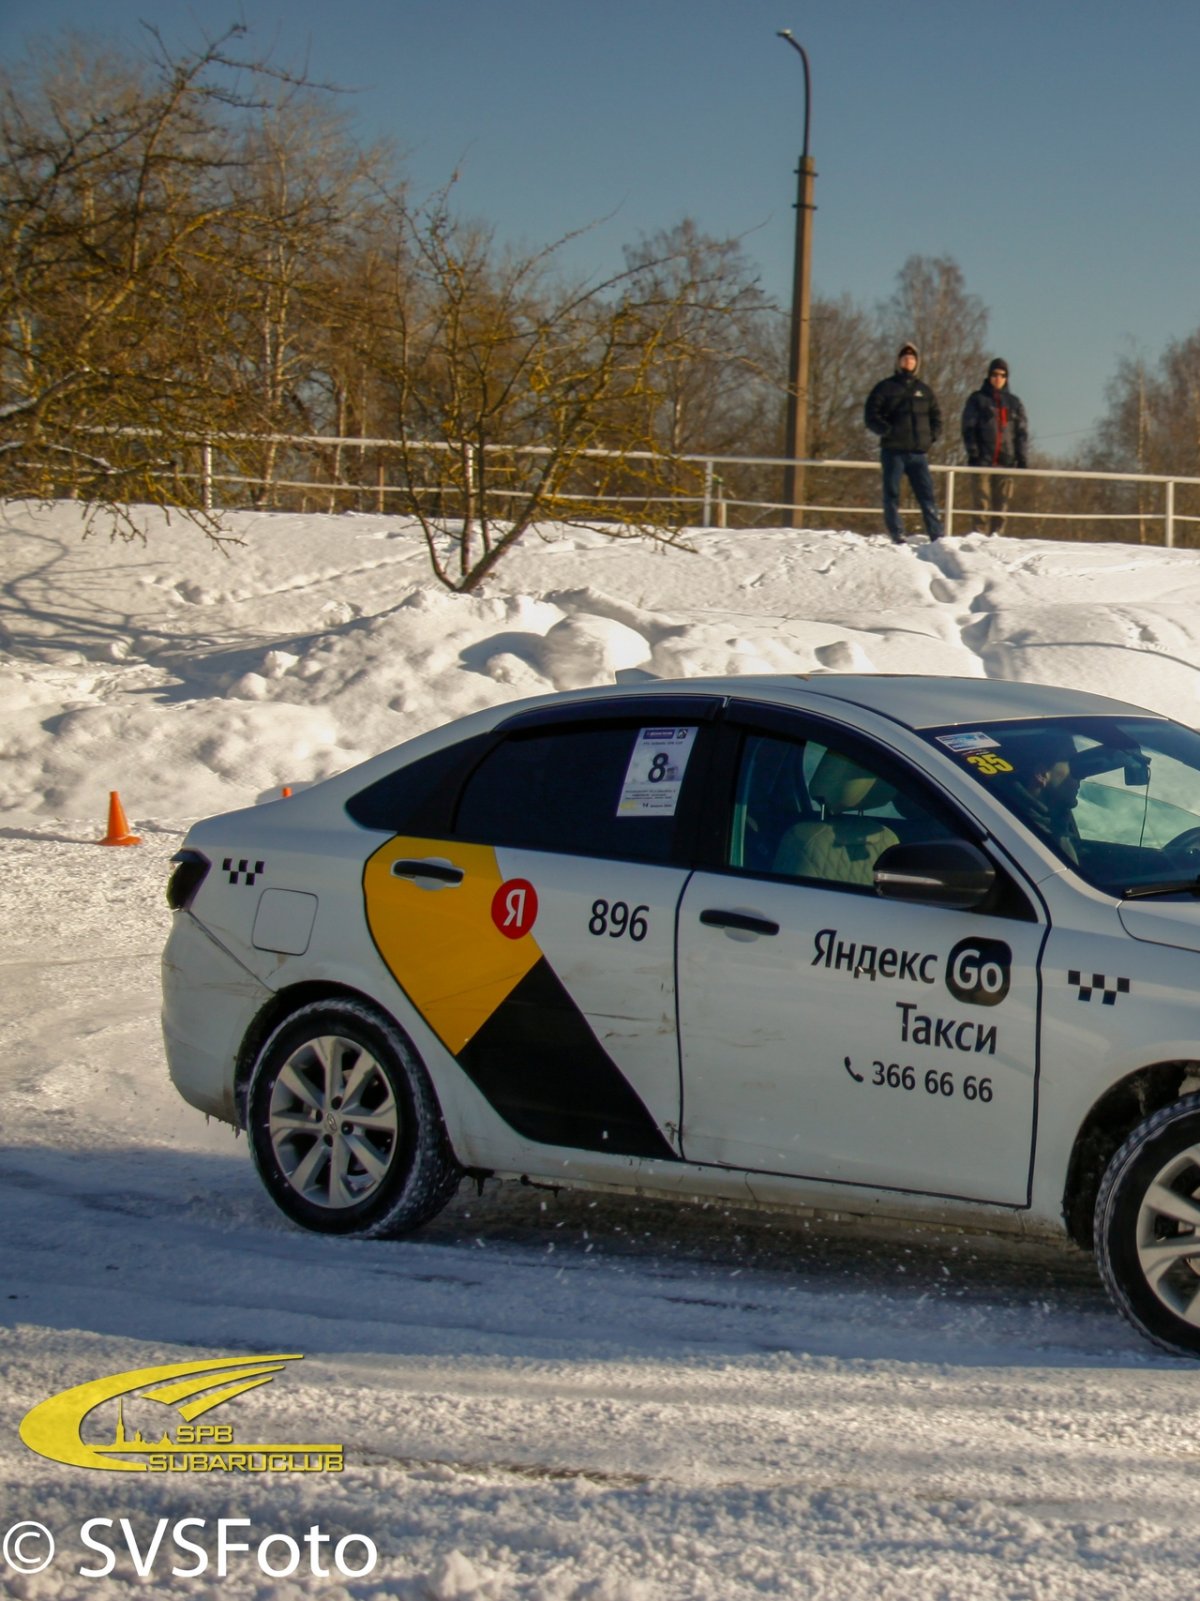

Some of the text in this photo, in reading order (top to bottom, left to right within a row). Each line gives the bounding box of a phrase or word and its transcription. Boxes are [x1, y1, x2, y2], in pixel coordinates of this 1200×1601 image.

[648, 752, 669, 783] 8
[966, 753, 1014, 775] 35
[503, 888, 526, 927] Я
[588, 898, 650, 942] 896
[811, 928, 1004, 993] Яндекс Go
[895, 1001, 998, 1056] Такси
[871, 1061, 994, 1103] 366 66 66
